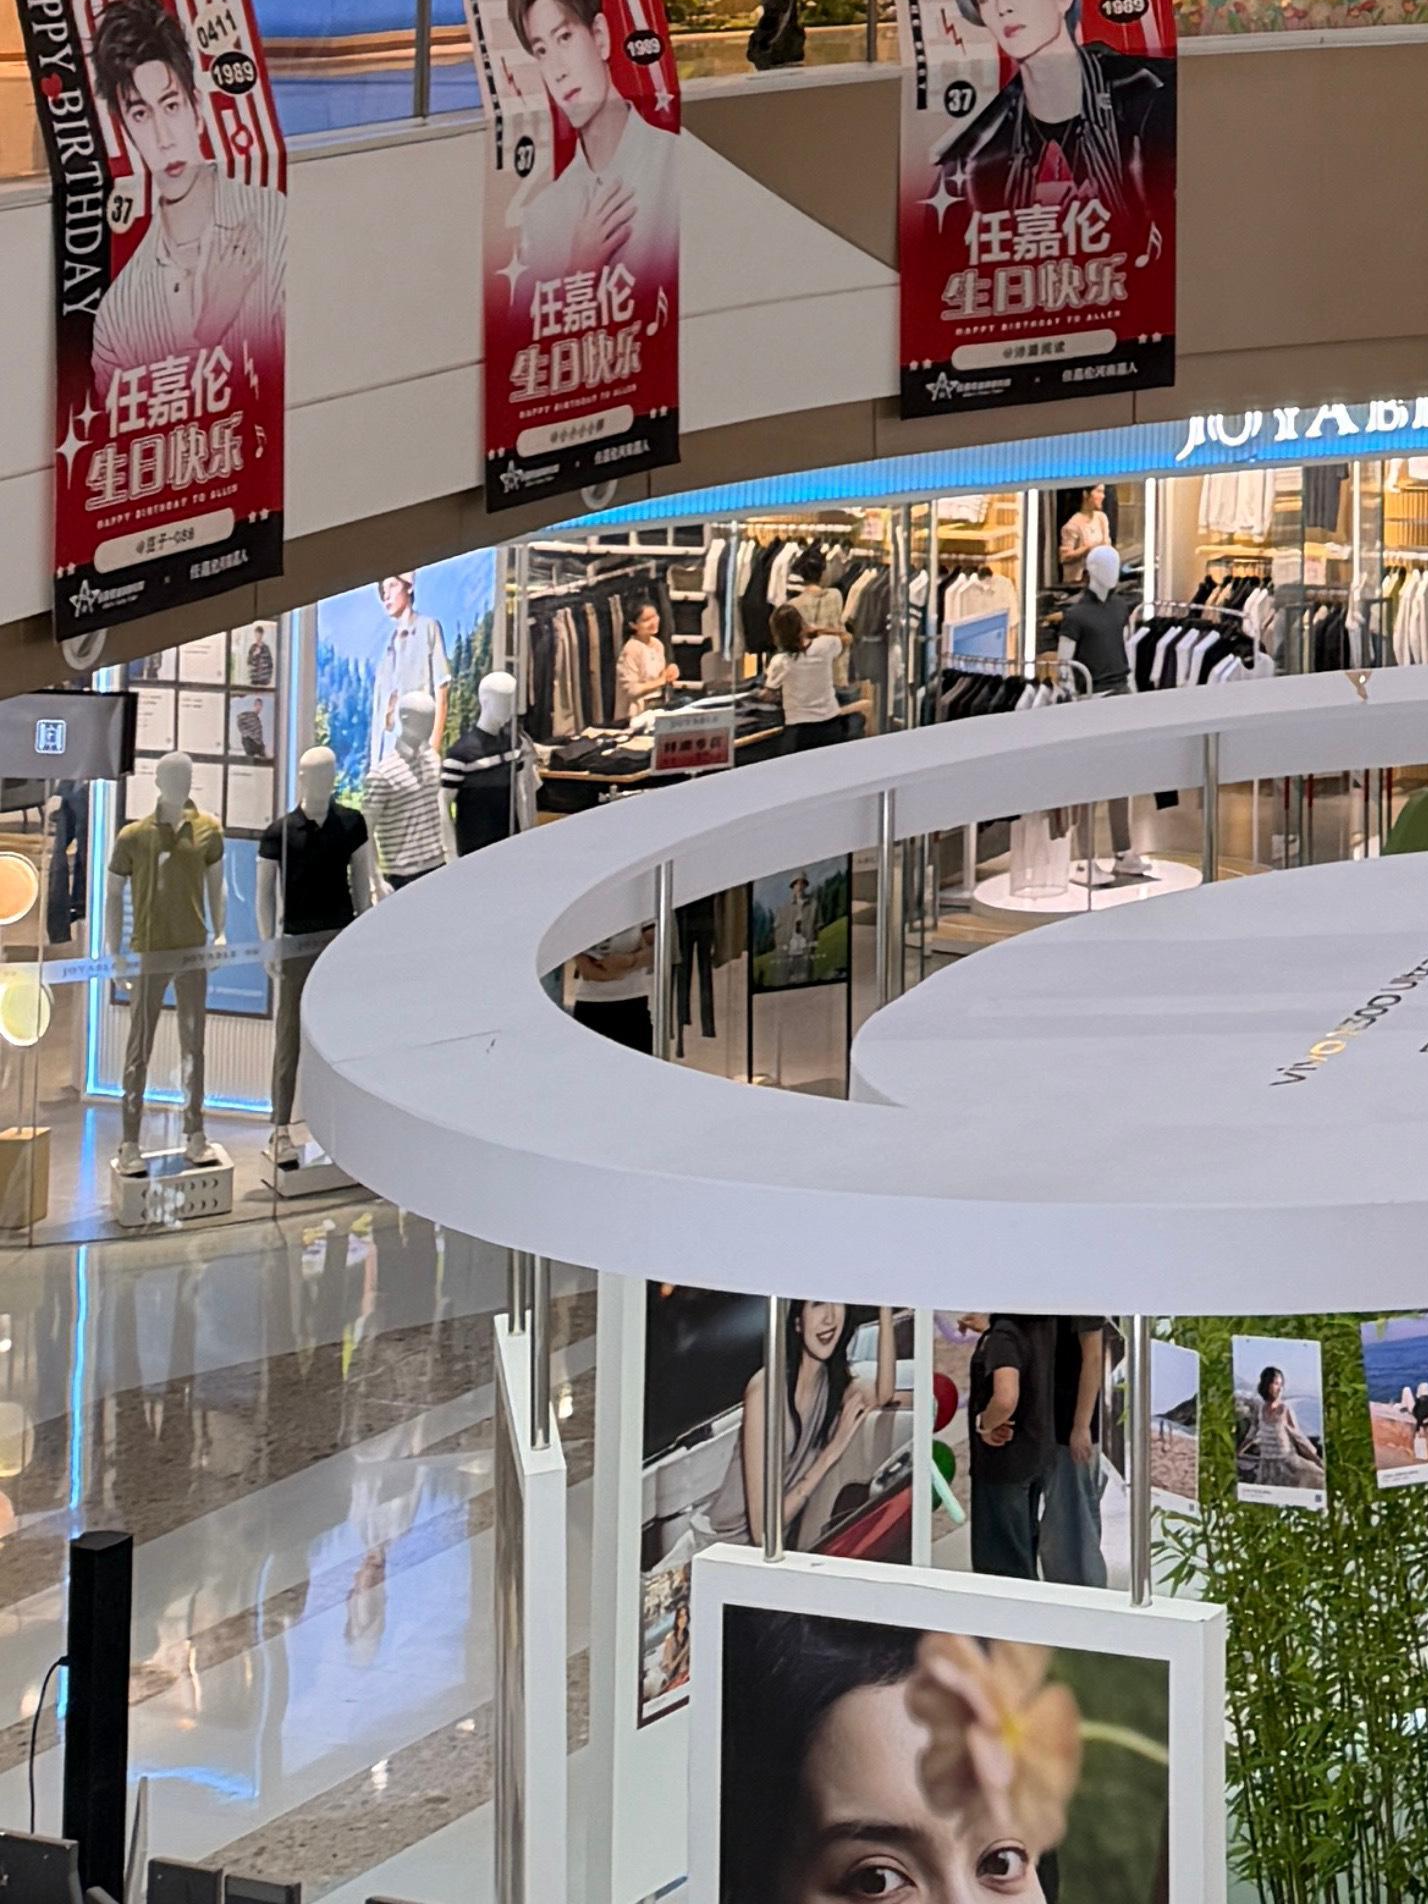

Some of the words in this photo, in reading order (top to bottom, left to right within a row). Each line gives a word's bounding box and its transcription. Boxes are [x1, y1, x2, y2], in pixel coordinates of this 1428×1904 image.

[198, 15, 237, 50] 0411
[212, 60, 253, 86] 1989
[949, 87, 973, 110] 37
[48, 98, 104, 319] BIRTHDAY
[965, 198, 1110, 267] 任嘉伦
[529, 266, 636, 340] 任嘉伦
[942, 253, 1126, 322] 生日快乐
[107, 350, 232, 437] 任嘉伦
[509, 323, 642, 403] 生日快乐
[86, 414, 244, 512] 生日快乐
